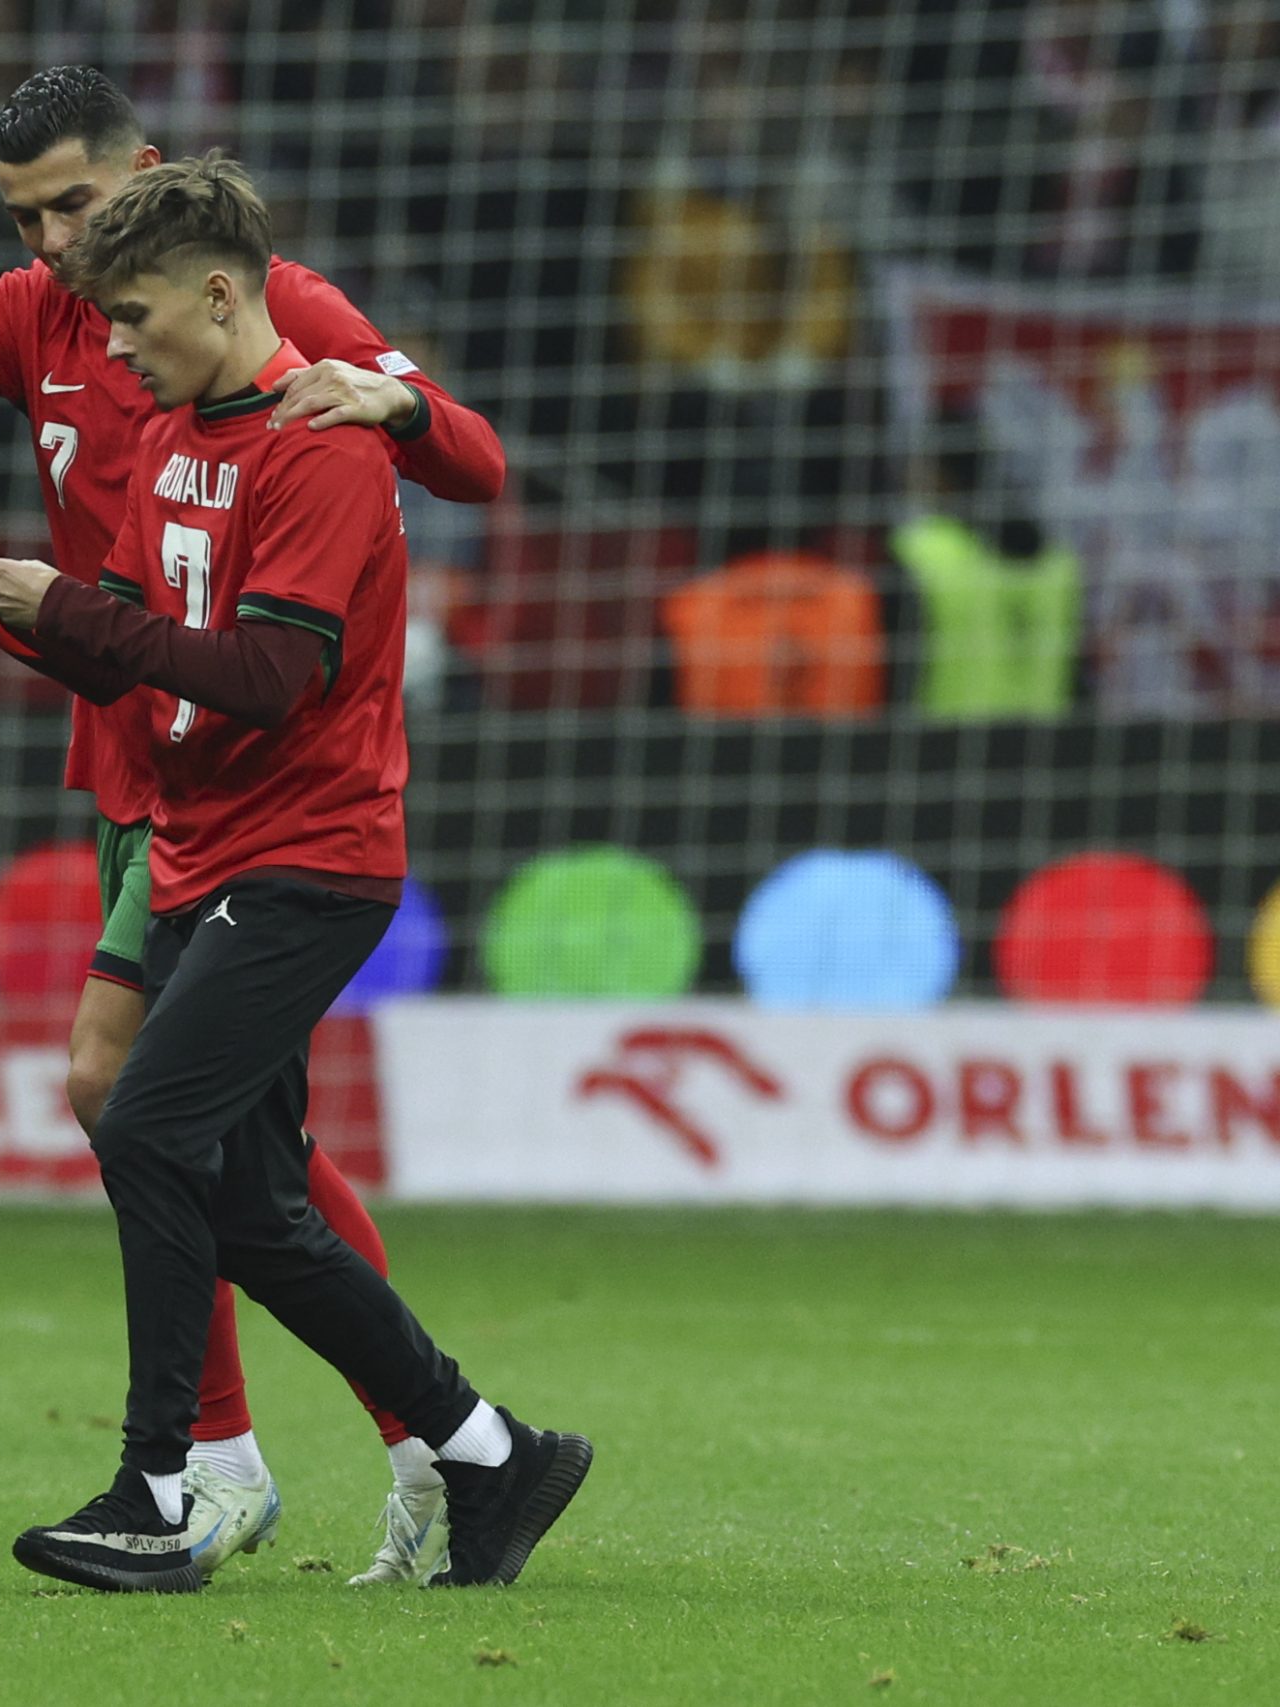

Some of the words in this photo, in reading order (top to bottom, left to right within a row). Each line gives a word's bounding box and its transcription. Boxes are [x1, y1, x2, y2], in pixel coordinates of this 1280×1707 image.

[39, 421, 78, 510] 7
[153, 453, 238, 509] RONALDO
[161, 521, 211, 742] 7
[844, 1056, 1280, 1145] ORLEN
[125, 1536, 181, 1551] SPLY-350
